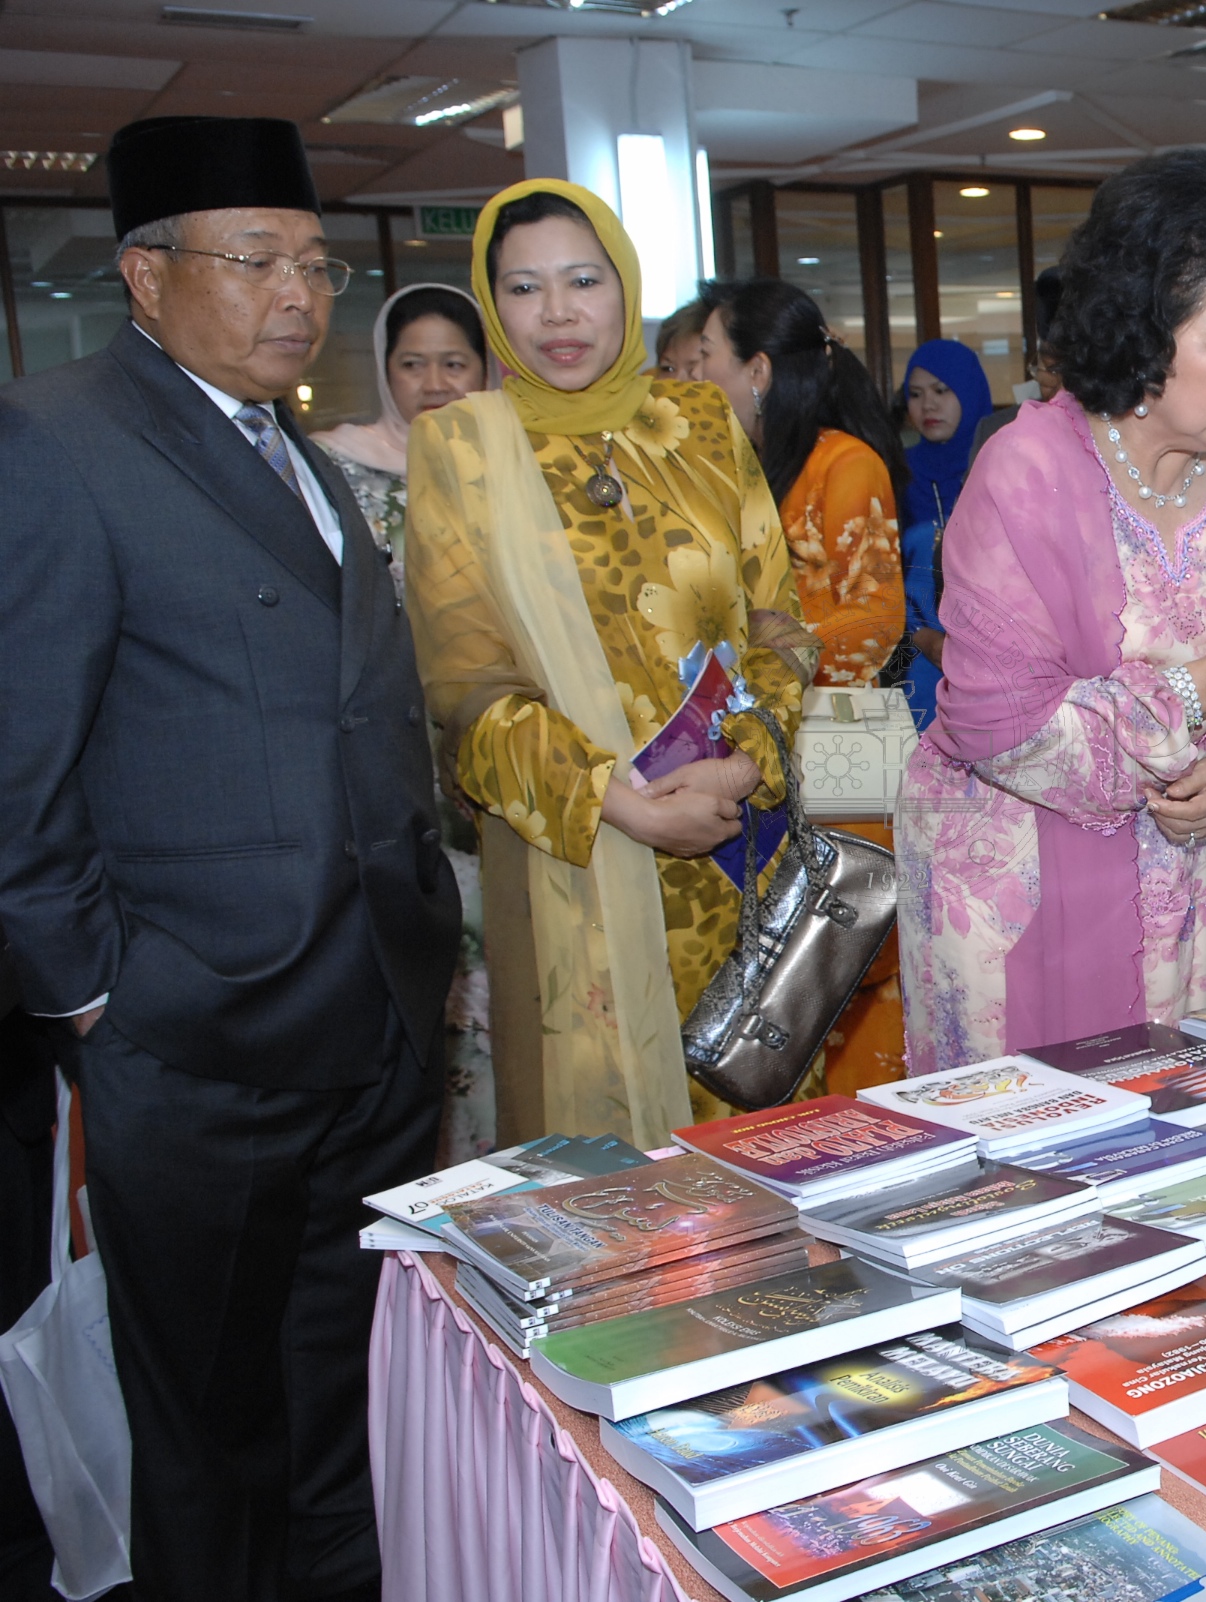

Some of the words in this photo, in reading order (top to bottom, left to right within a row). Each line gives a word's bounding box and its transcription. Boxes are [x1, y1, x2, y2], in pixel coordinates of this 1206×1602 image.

[1014, 1098, 1058, 1113] BANGSA
[1058, 1091, 1082, 1100] DAN
[969, 1111, 1013, 1125] MELAYU
[979, 1094, 1096, 1128] INDONESIA
[991, 1097, 1107, 1131] REVOLUSI
[722, 1108, 881, 1160] ARISTOTLE
[811, 1119, 924, 1156] PLATO
[757, 1148, 822, 1166] dan
[408, 1202, 429, 1215] 07
[538, 1203, 572, 1231] TULISAN
[569, 1227, 608, 1249] TANGAN
[1135, 1355, 1184, 1375] Malaysia
[1148, 1355, 1206, 1378] Vernakular
[828, 1372, 891, 1406] Pemikiran
[858, 1369, 911, 1395] Analisis
[1122, 1375, 1148, 1388] Cina
[986, 1439, 1043, 1472] SUNGAI
[1003, 1435, 1076, 1474] SEBERANG
[1023, 1432, 1071, 1460] DUNIA
